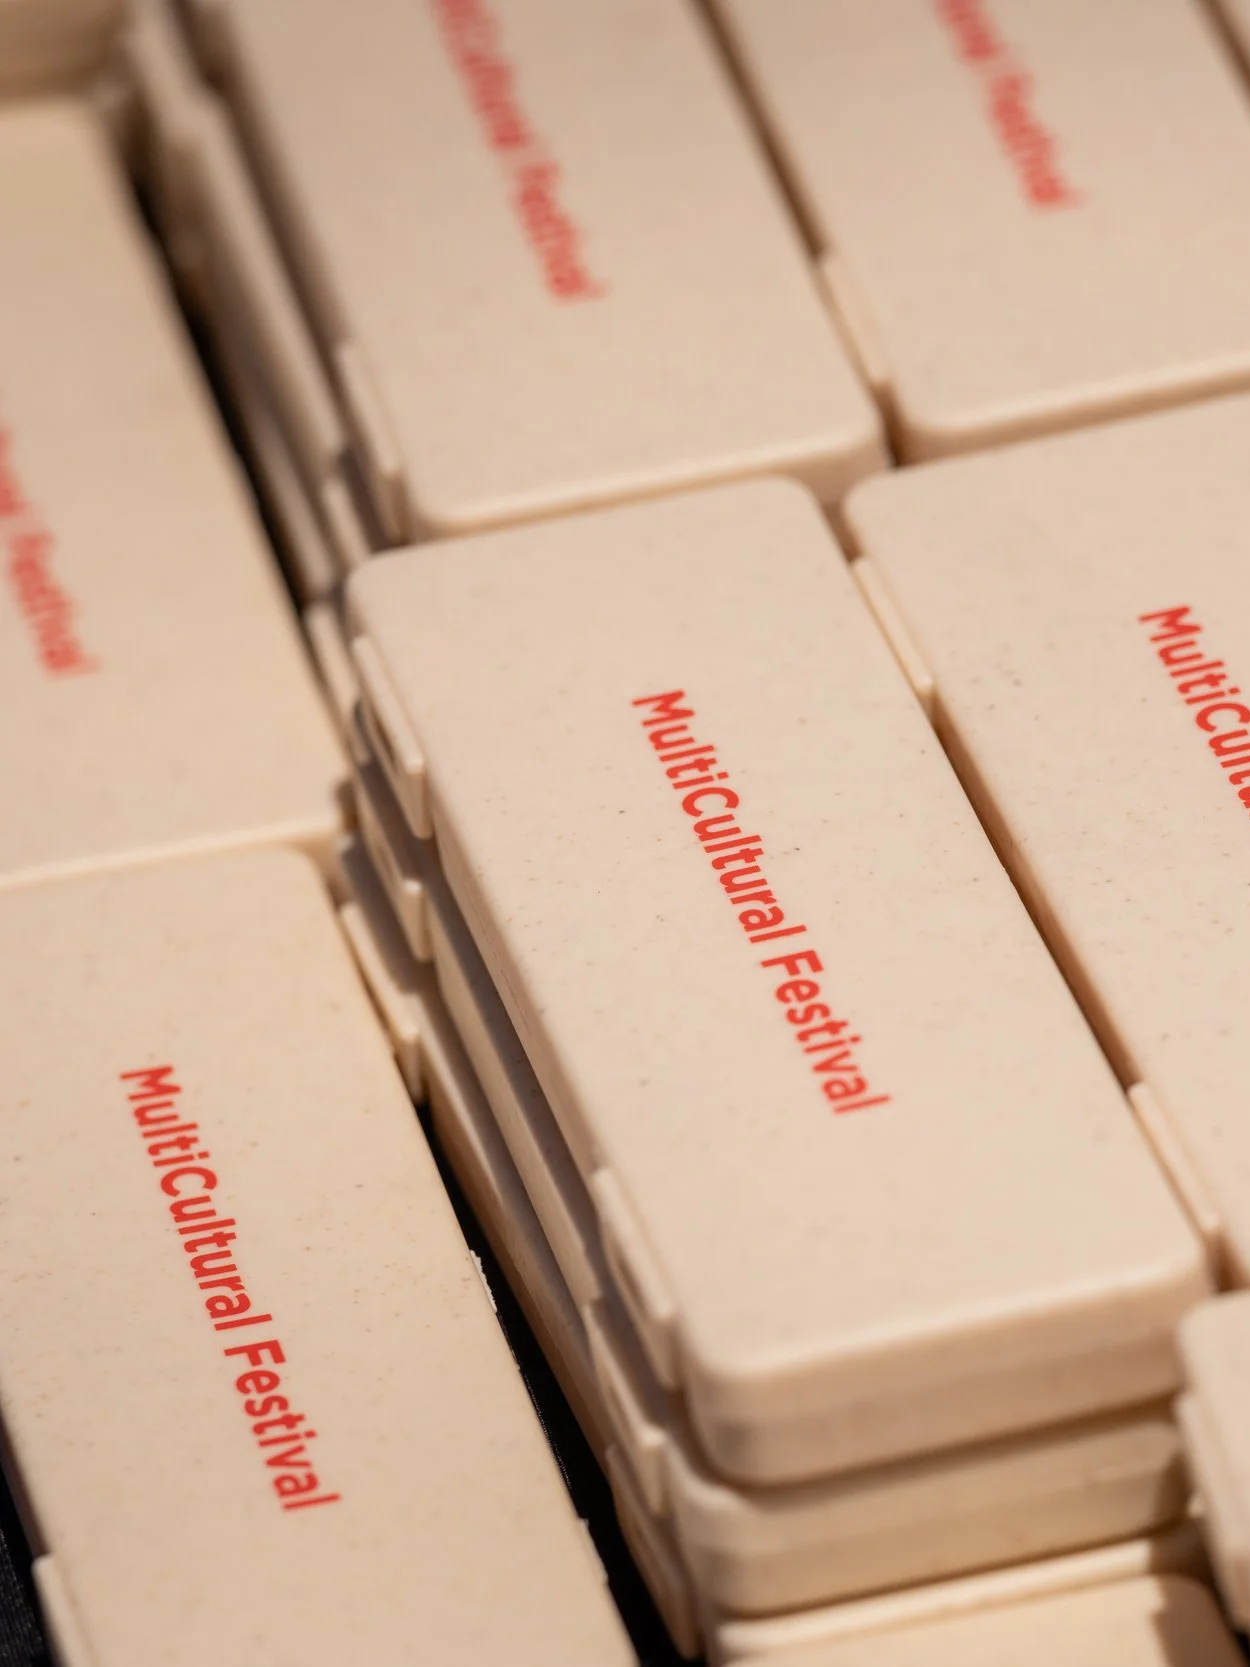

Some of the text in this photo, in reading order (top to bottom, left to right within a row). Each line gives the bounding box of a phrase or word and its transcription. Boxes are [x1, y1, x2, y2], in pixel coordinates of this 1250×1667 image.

[630, 687, 891, 1116] MultiCultural Festival
[118, 1063, 342, 1512] MultiCultural Festival
